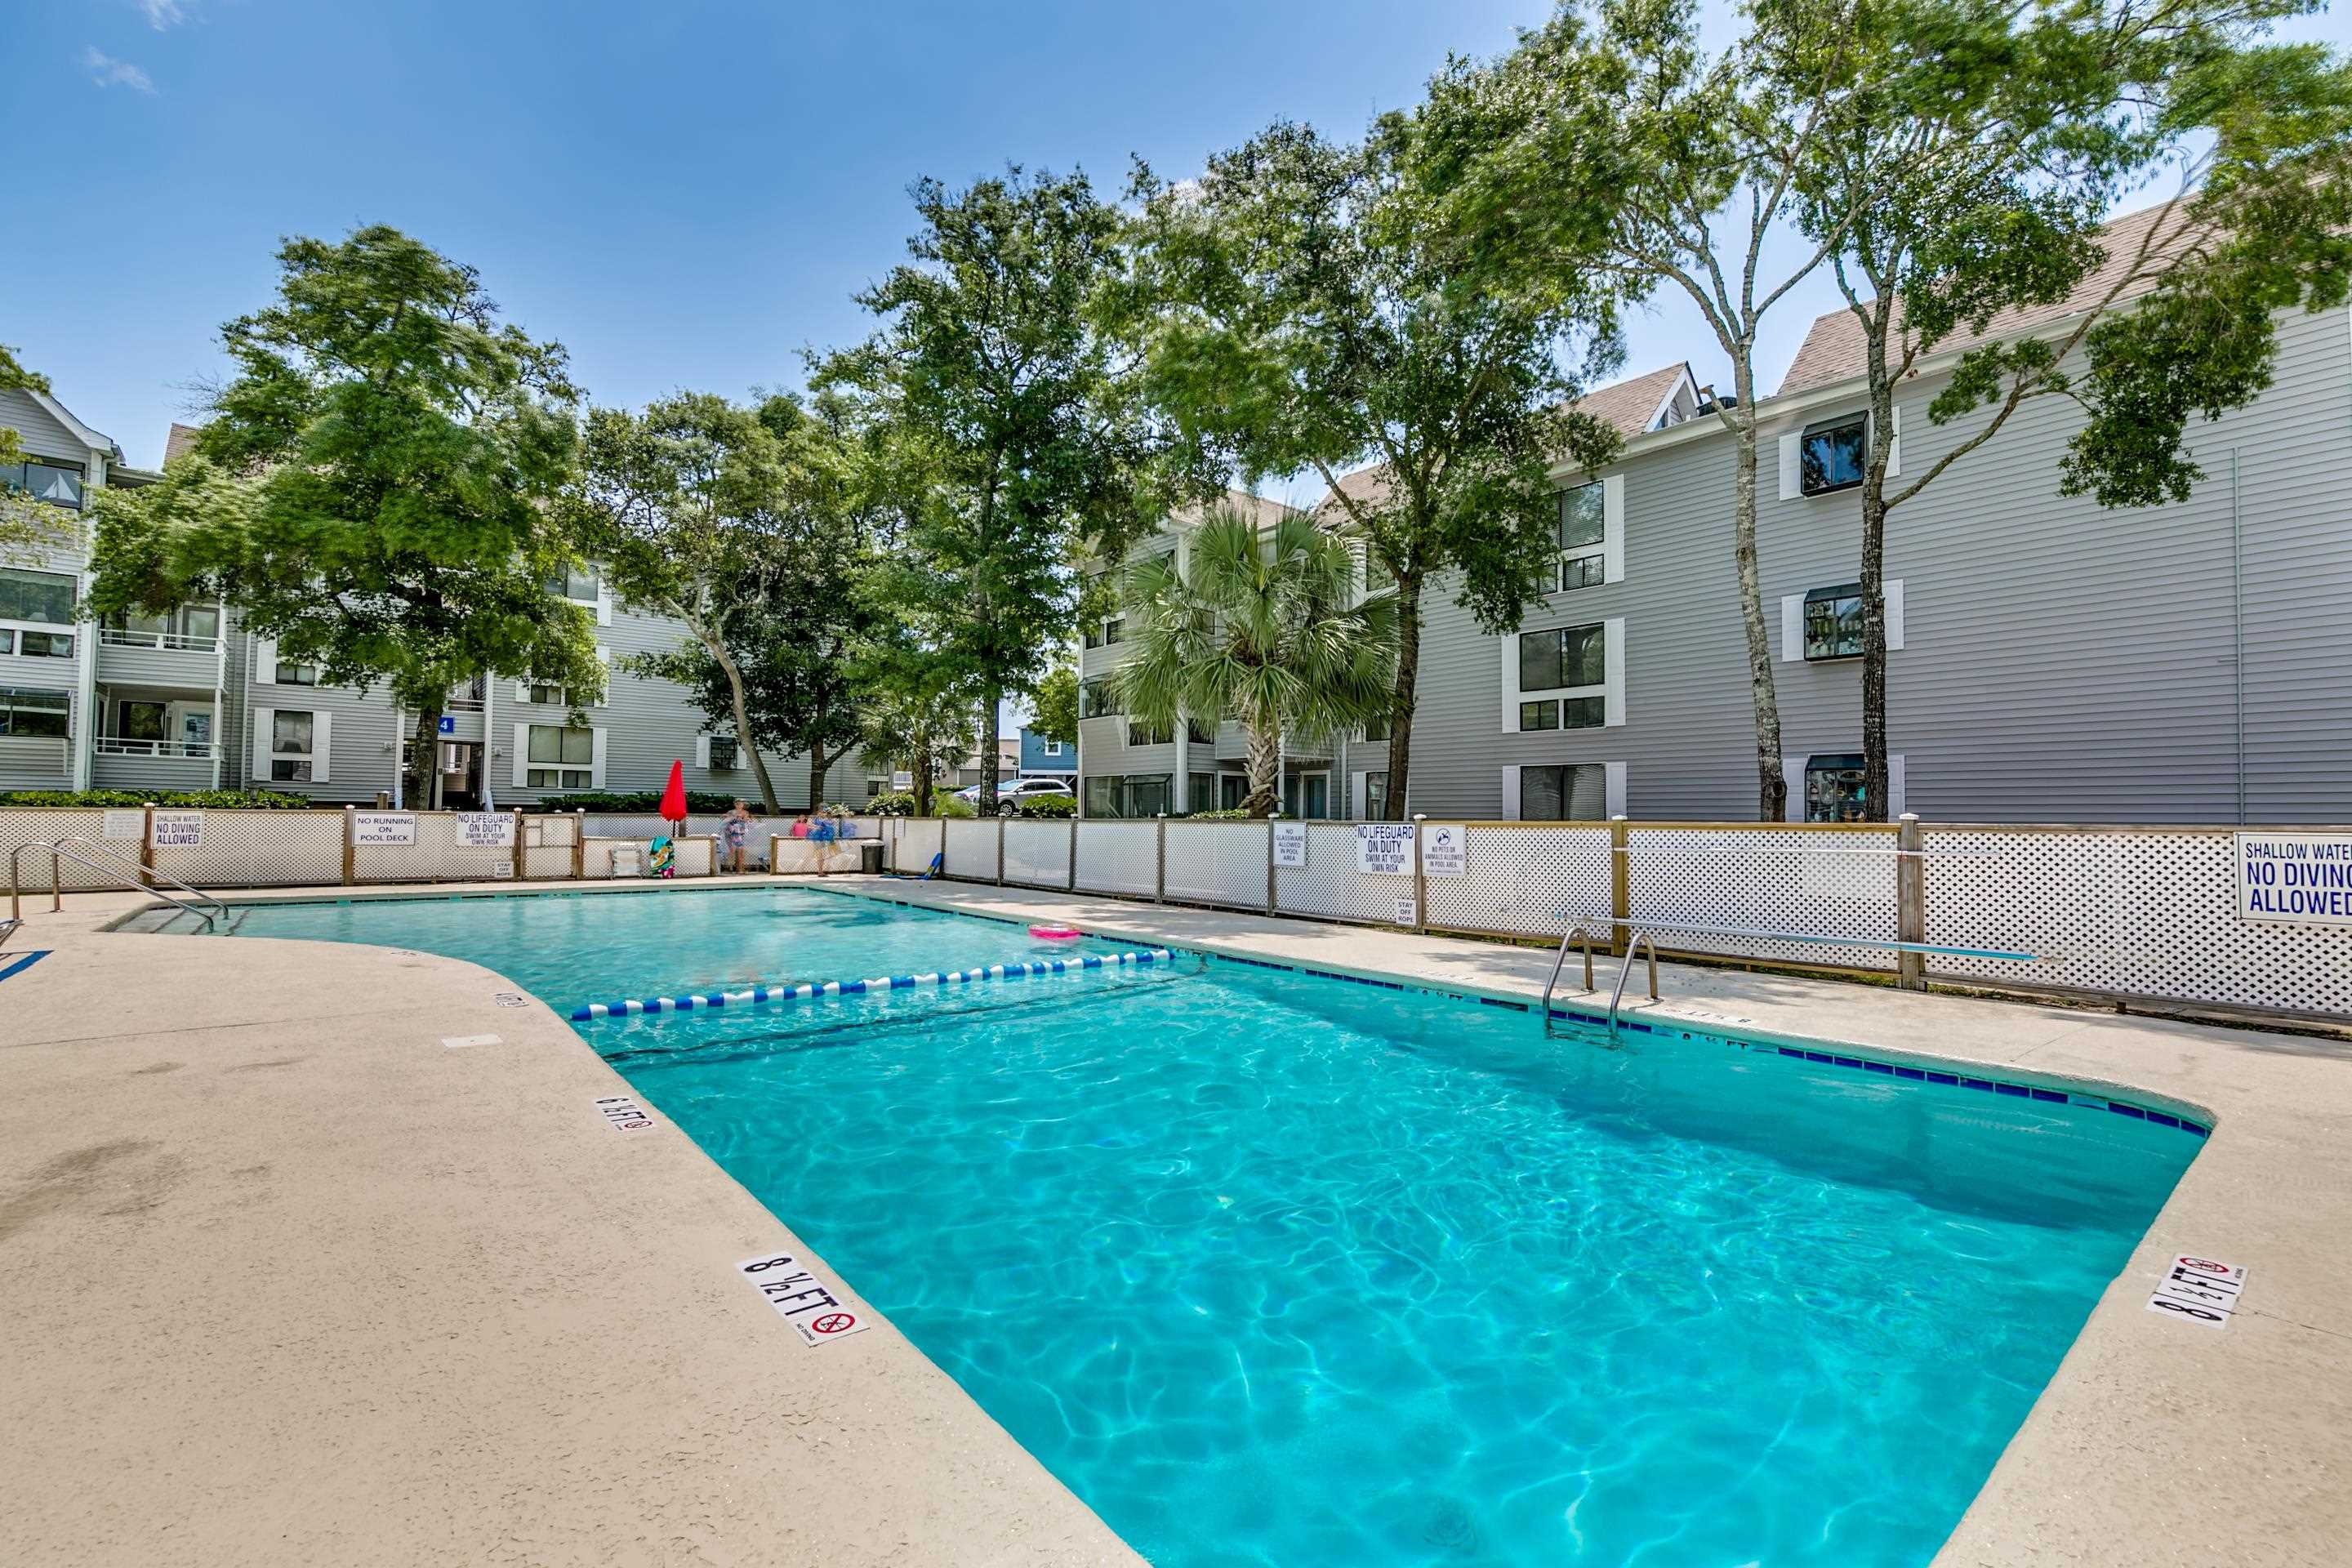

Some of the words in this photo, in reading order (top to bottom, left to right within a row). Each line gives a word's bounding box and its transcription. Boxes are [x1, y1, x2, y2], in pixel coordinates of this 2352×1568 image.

[440, 720, 448, 730] 4
[458, 814, 470, 823] NO
[471, 814, 514, 823] LIFEGUARD
[156, 823, 169, 833] NO
[172, 823, 200, 833] DIVING
[469, 823, 480, 832] ON
[482, 823, 503, 833] DUTY
[1357, 826, 1368, 839] NO
[1370, 826, 1414, 840] LIFEGUARD
[156, 834, 199, 844] ALLOWED
[1367, 840, 1379, 853] ON
[1380, 840, 1401, 853] DUTY
[2246, 842, 2308, 859] SHALLOW
[2312, 844, 2352, 860] WATE
[1365, 853, 1380, 862] SWIM
[1382, 854, 1388, 863] AT
[1390, 854, 1405, 864] YOUR
[1371, 863, 1385, 872] OWN
[1385, 863, 1399, 873] RISK
[2247, 862, 2275, 885] NO
[606, 1111, 648, 1122] FT
[2170, 1266, 2240, 1295] FT
[744, 1257, 793, 1272] 8
[773, 1287, 840, 1316] FT
[2153, 1300, 2223, 1321] 8
